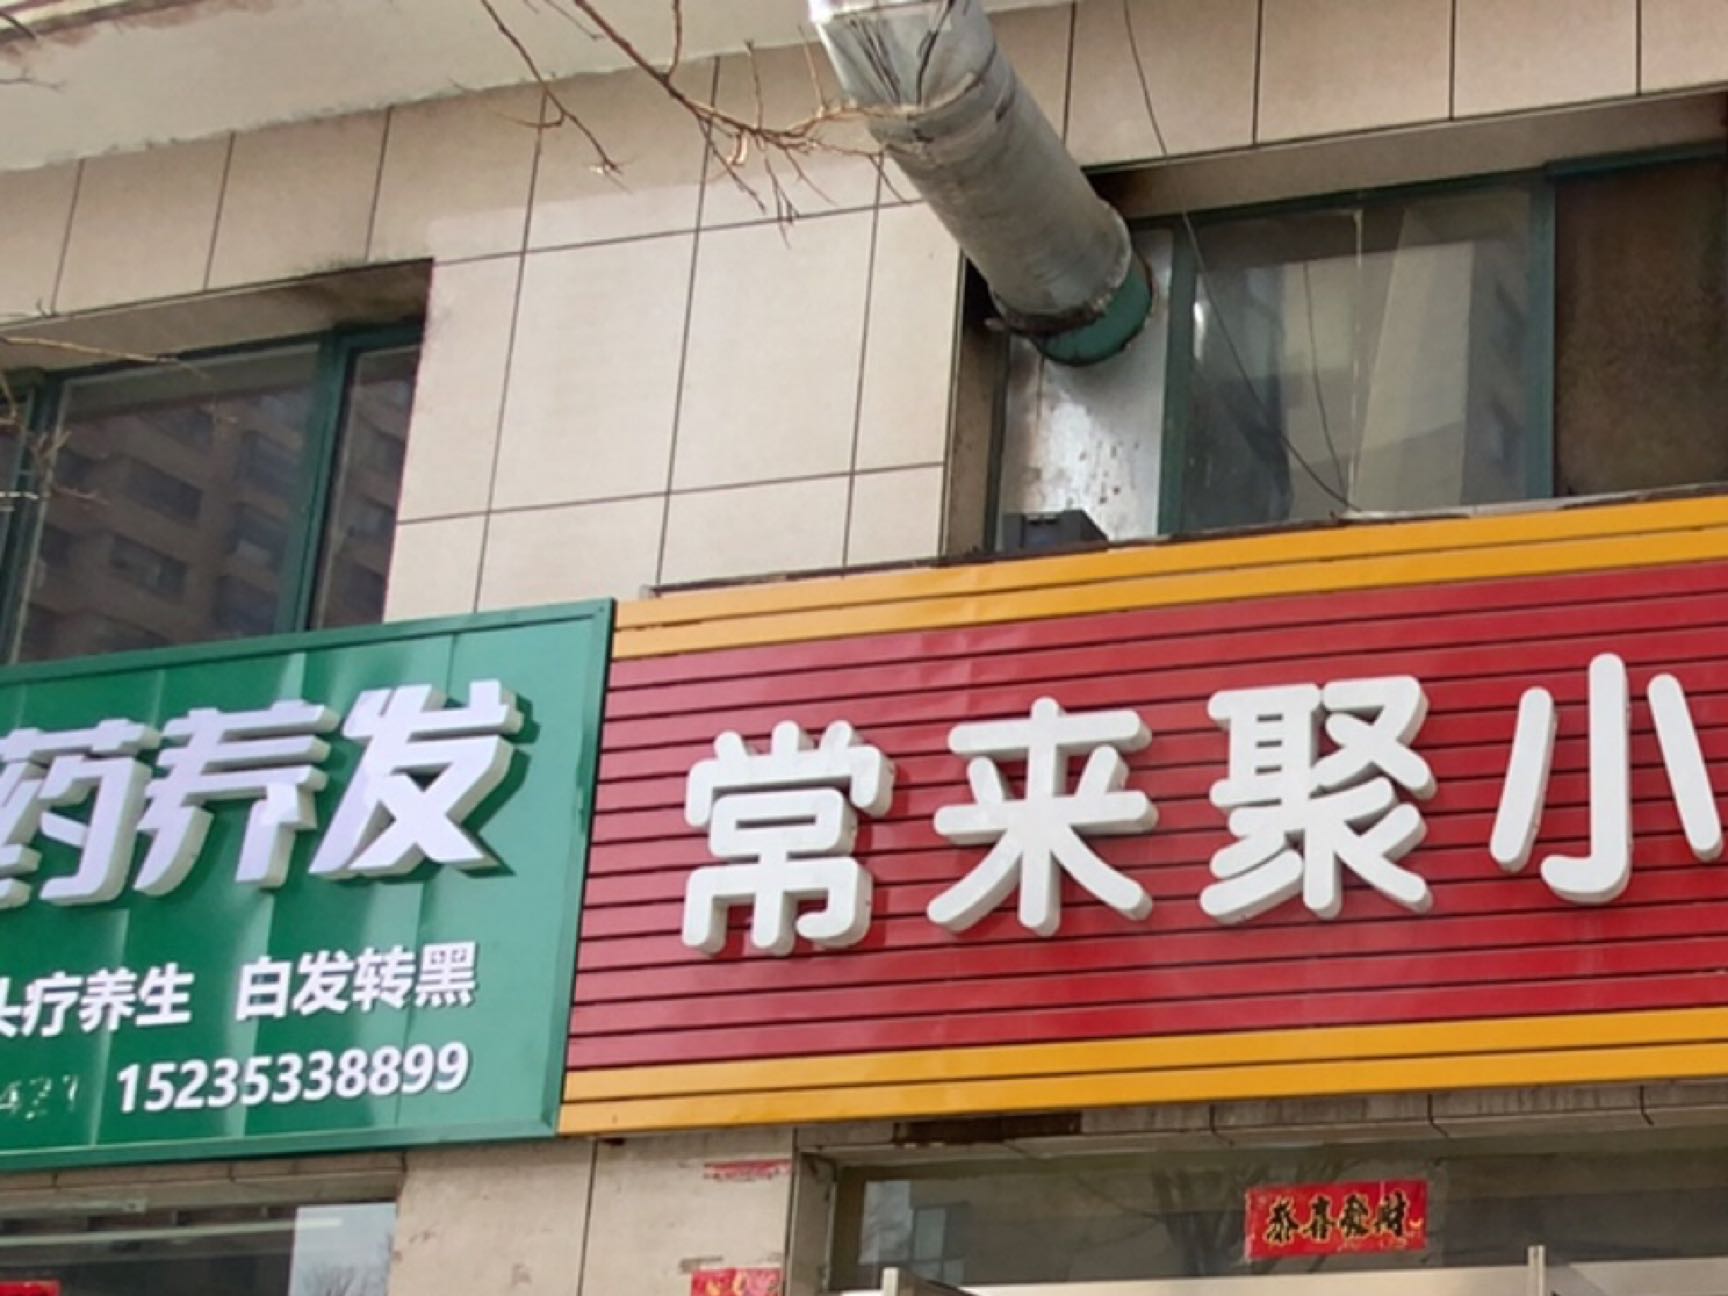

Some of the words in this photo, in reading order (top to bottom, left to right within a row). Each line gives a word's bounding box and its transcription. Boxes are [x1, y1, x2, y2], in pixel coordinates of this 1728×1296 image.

[235, 941, 477, 1021] 白发转黑
[117, 1042, 469, 1113] 15235338899
